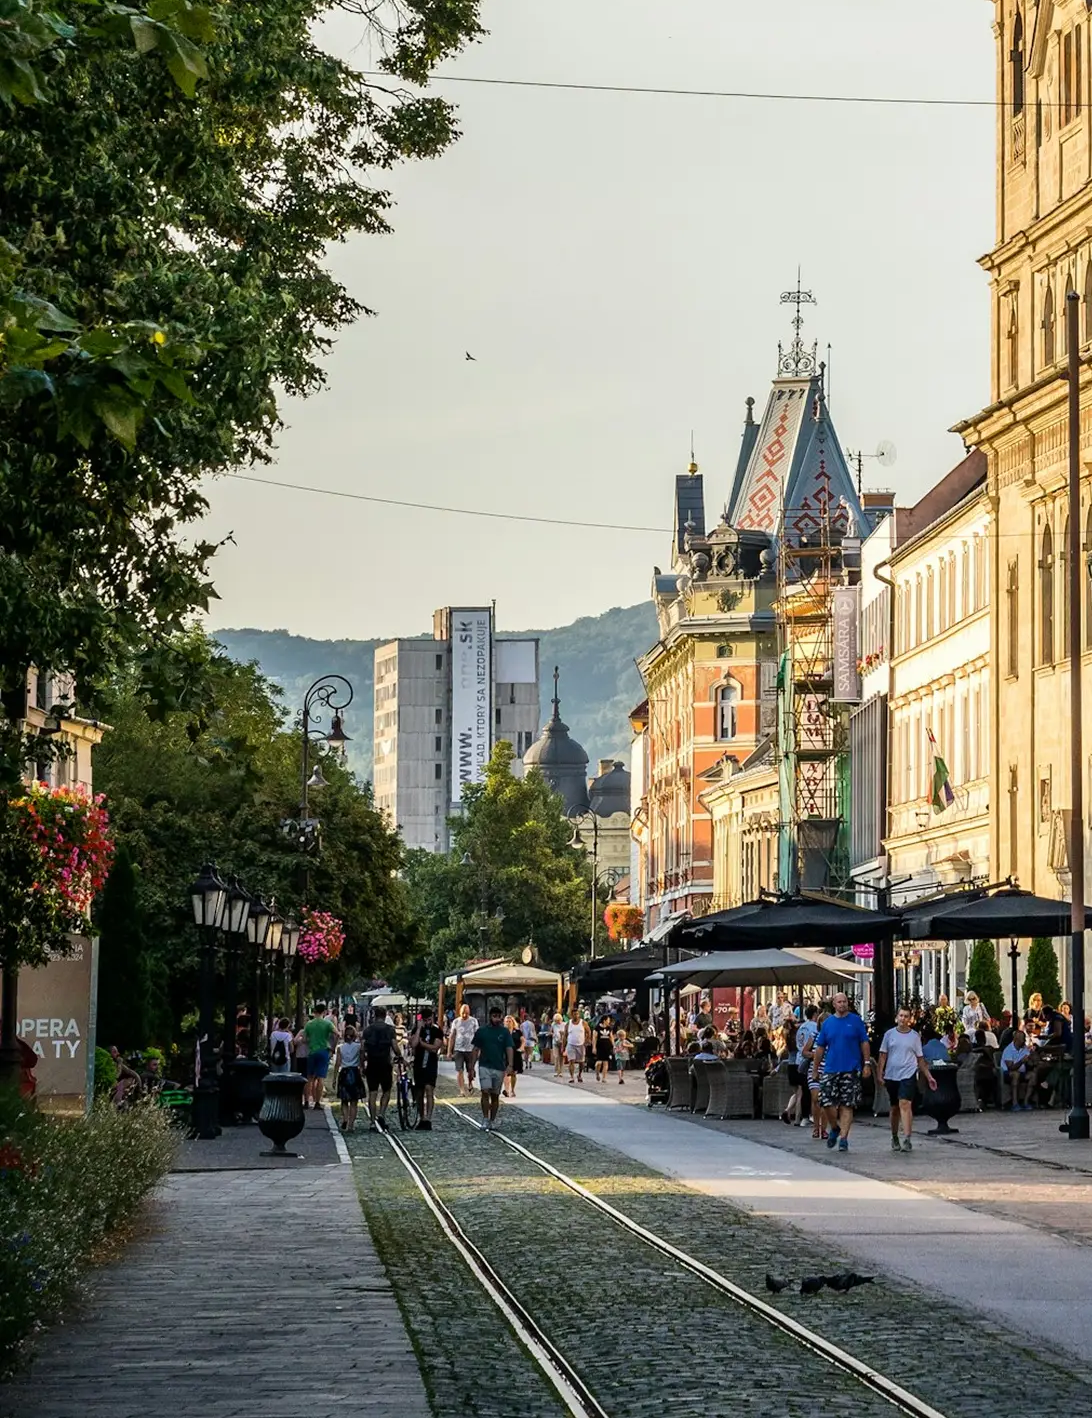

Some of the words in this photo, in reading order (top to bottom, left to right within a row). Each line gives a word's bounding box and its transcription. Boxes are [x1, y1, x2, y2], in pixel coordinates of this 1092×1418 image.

[476, 620, 488, 684] NEZOPAKUJE
[476, 688, 486, 702] SA
[16, 1018, 80, 1038] PERA
[52, 1040, 81, 1059] TY
